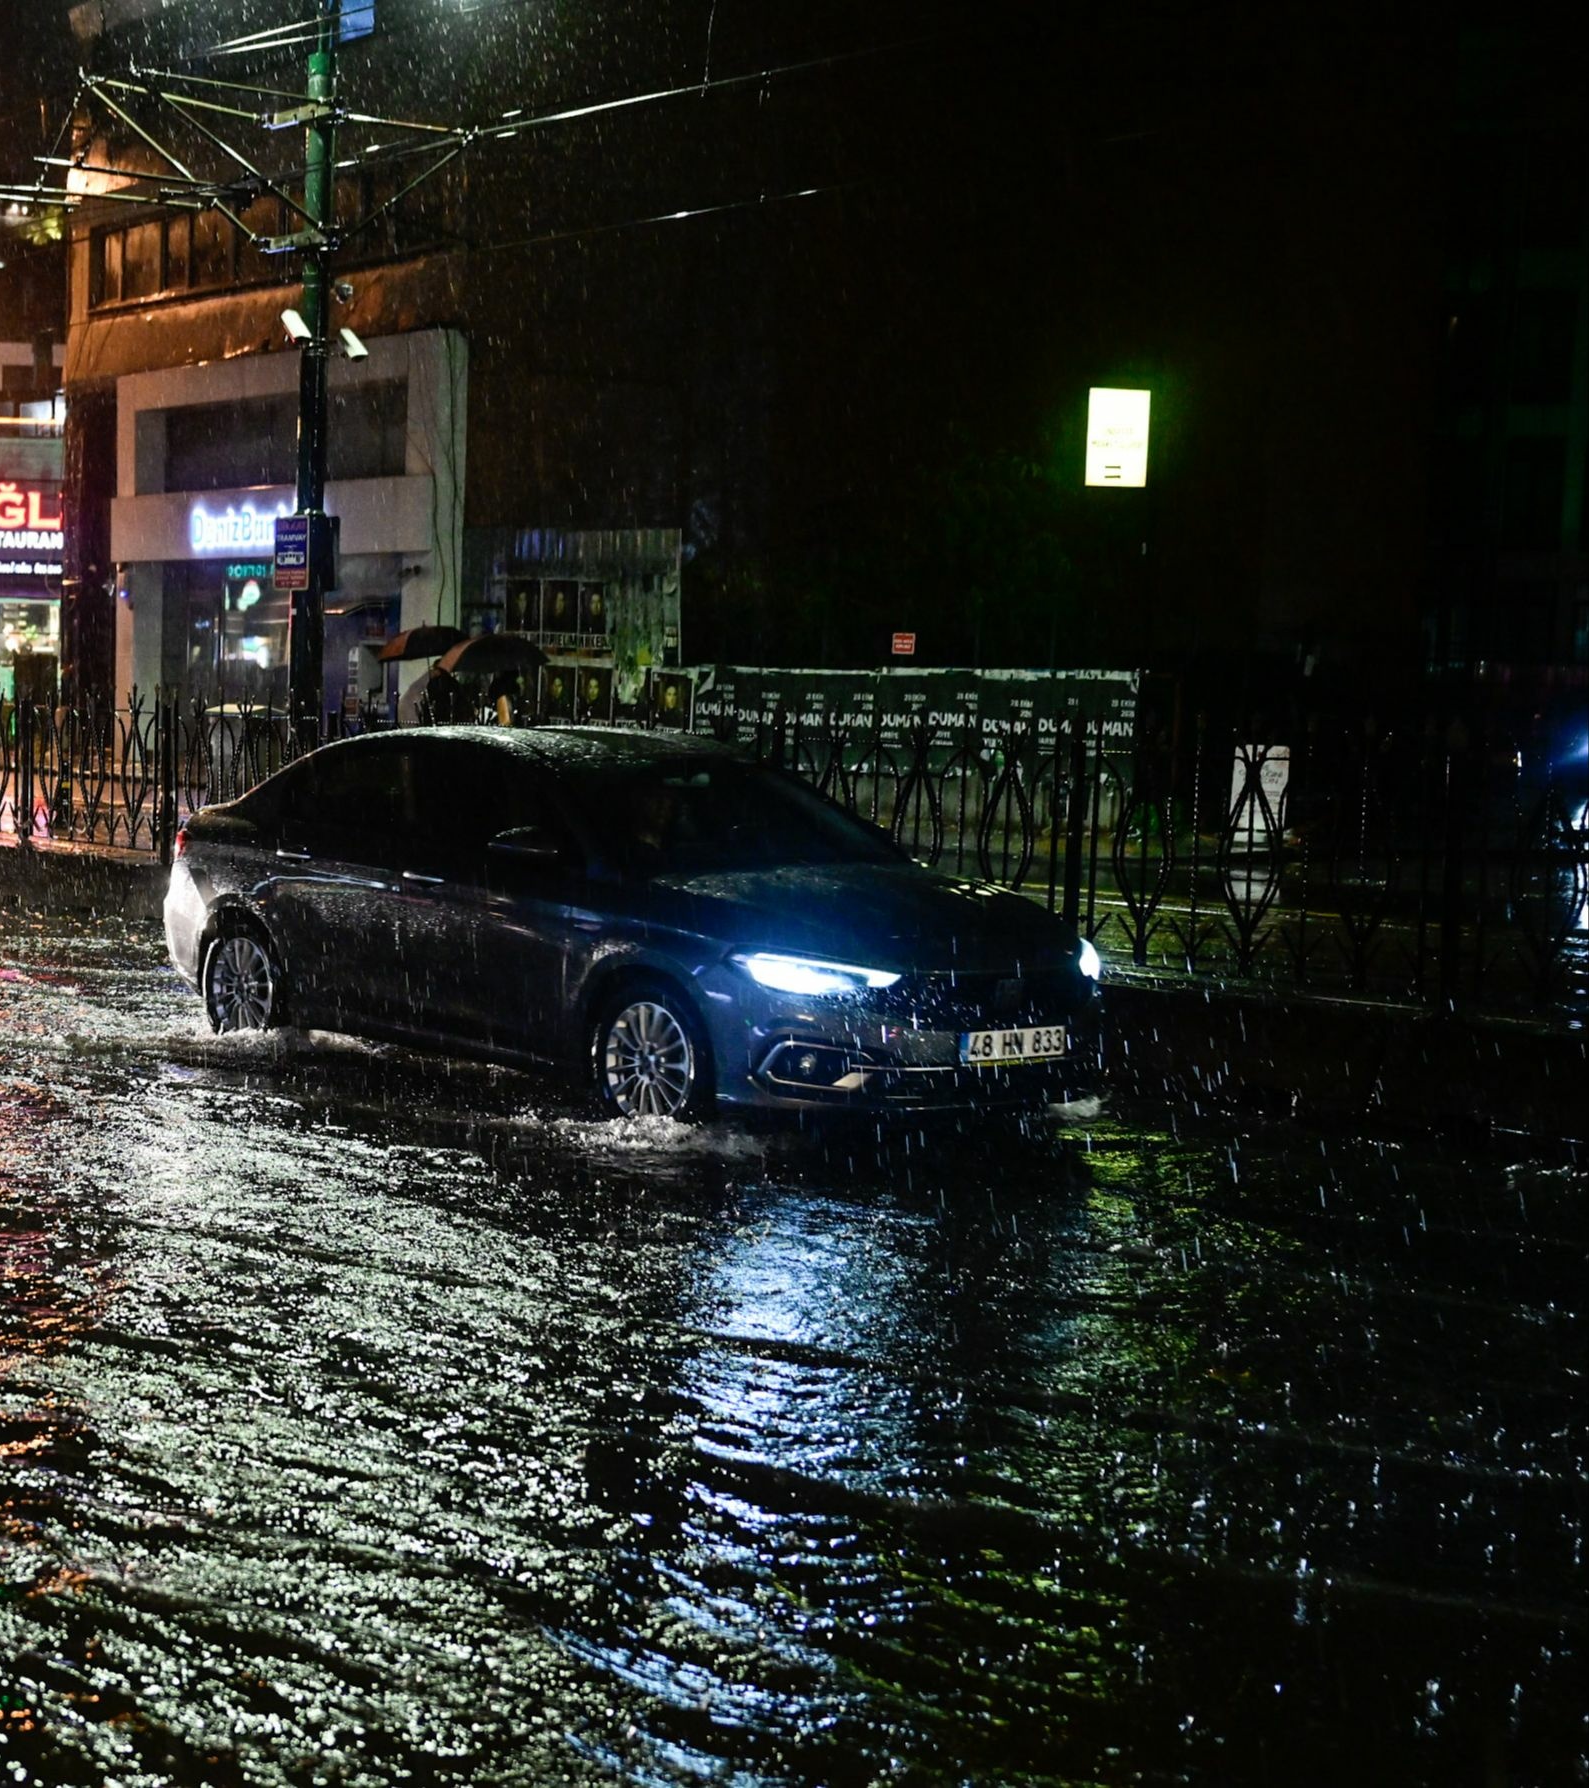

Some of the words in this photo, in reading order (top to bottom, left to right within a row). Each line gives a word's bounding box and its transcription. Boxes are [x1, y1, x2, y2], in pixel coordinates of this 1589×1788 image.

[191, 504, 282, 550] DenizBan
[928, 711, 977, 728] DUMAN
[969, 1034, 993, 1057] 48
[1002, 1032, 1024, 1055] HN
[1033, 1029, 1063, 1052] 833
